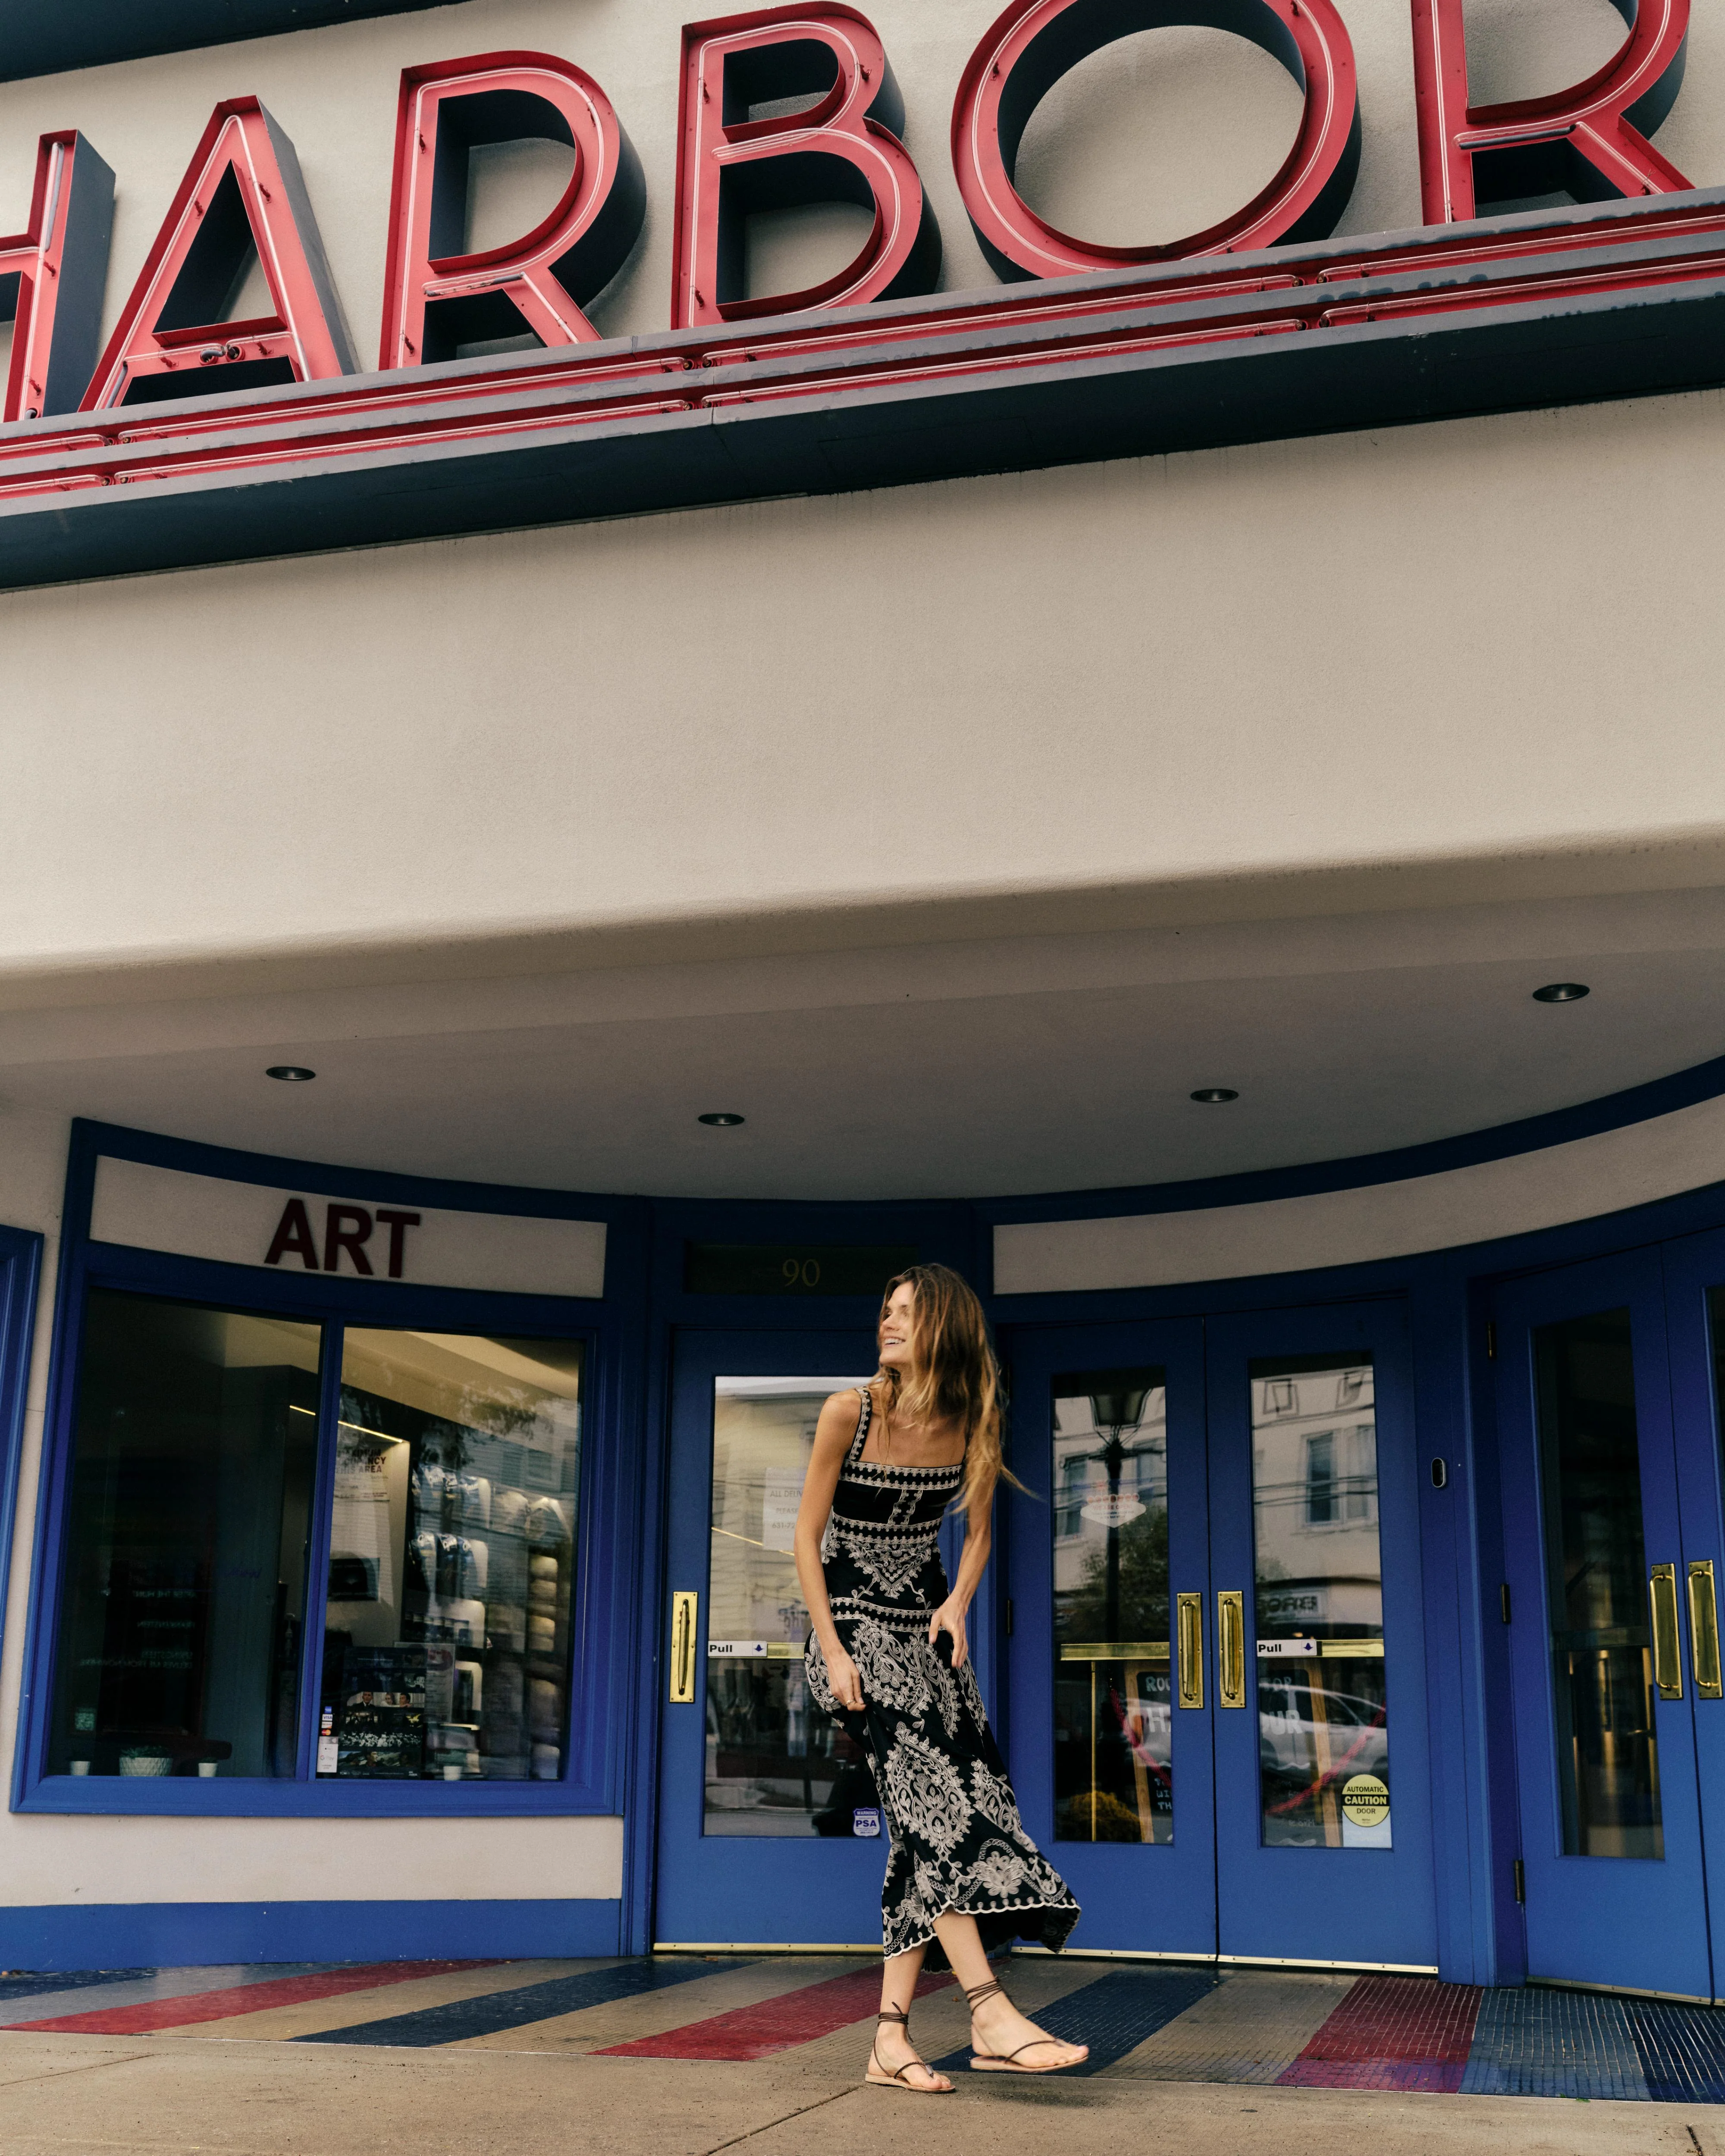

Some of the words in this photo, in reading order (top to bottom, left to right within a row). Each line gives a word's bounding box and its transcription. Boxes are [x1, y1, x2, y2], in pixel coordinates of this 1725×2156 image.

[264, 1198, 420, 1279] ART
[783, 1259, 820, 1287] 90
[1258, 1644, 1282, 1652] Pull
[1345, 1796, 1387, 1805] CAUTION
